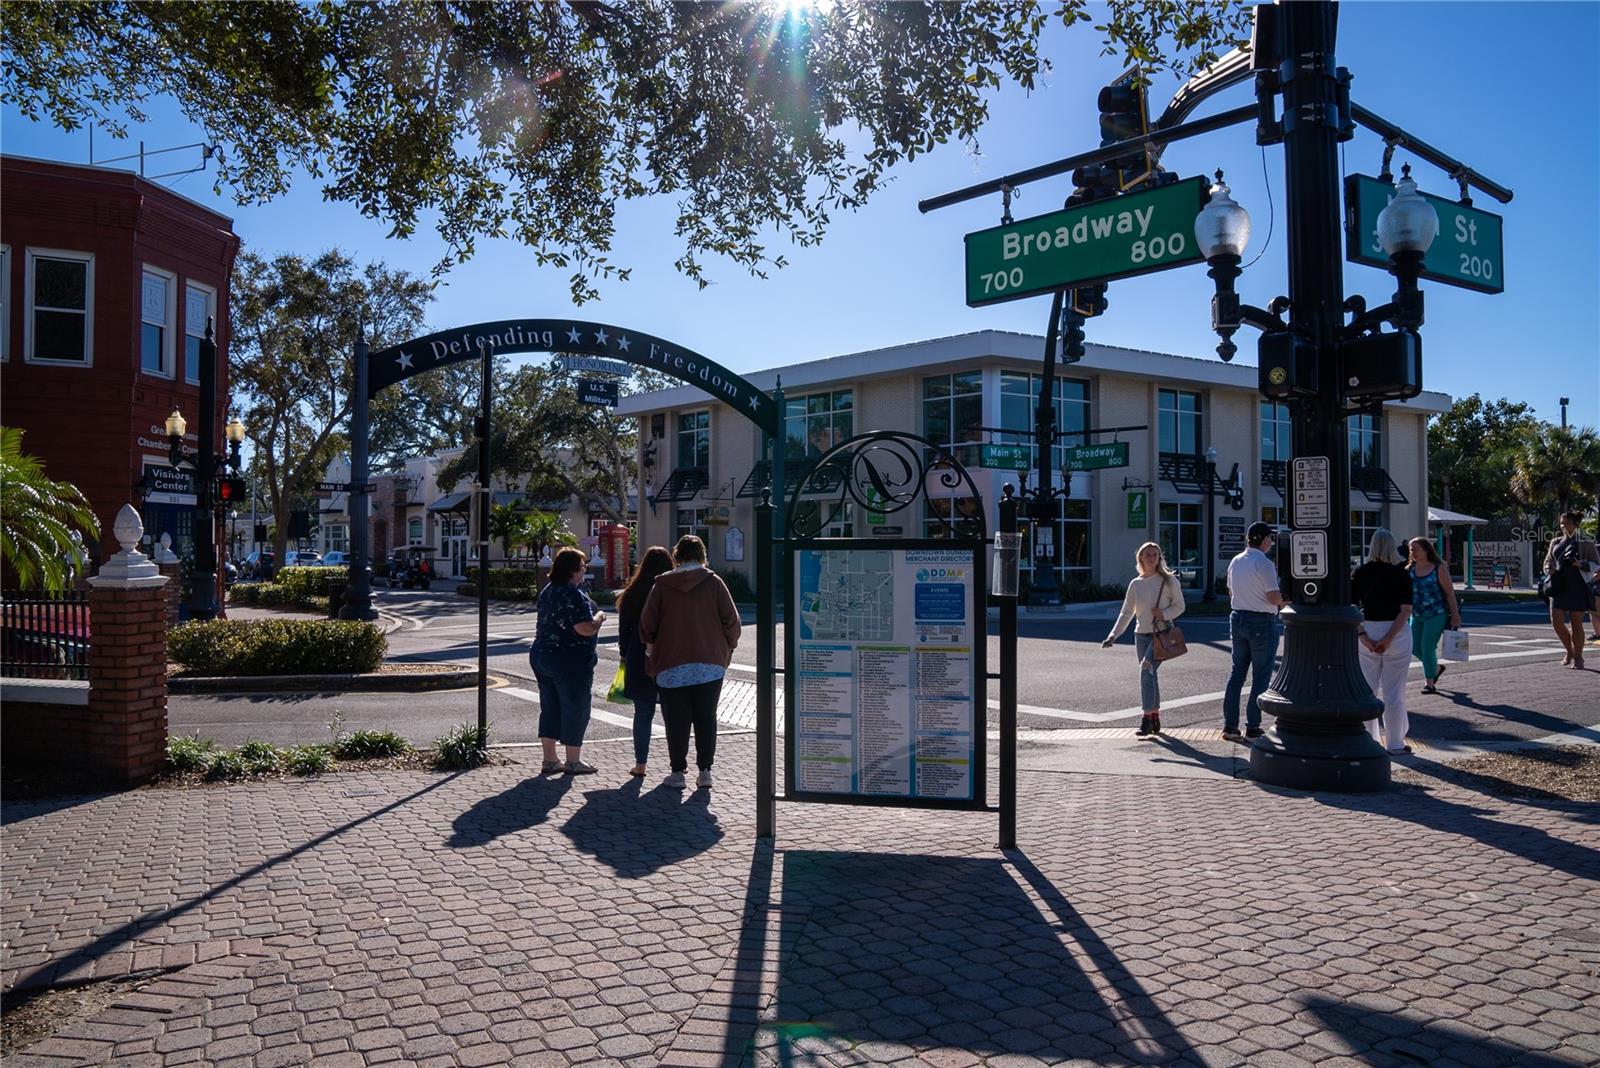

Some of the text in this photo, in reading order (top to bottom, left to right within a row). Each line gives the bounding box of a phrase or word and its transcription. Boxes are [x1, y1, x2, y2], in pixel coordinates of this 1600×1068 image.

[1002, 205, 1155, 260] Broadway
[1455, 214, 1477, 246] St
[980, 232, 1185, 294] 700 800
[1460, 253, 1493, 280] 200
[430, 325, 738, 397] Defending Freedom
[572, 358, 626, 374] HONORING
[590, 383, 608, 392] U.S.
[990, 448, 1021, 458] Main St
[1076, 448, 1115, 459] Broadway
[152, 468, 190, 480] Visitors
[154, 480, 188, 491] Center
[1474, 543, 1517, 552] West End
[931, 568, 963, 577] DDMA
